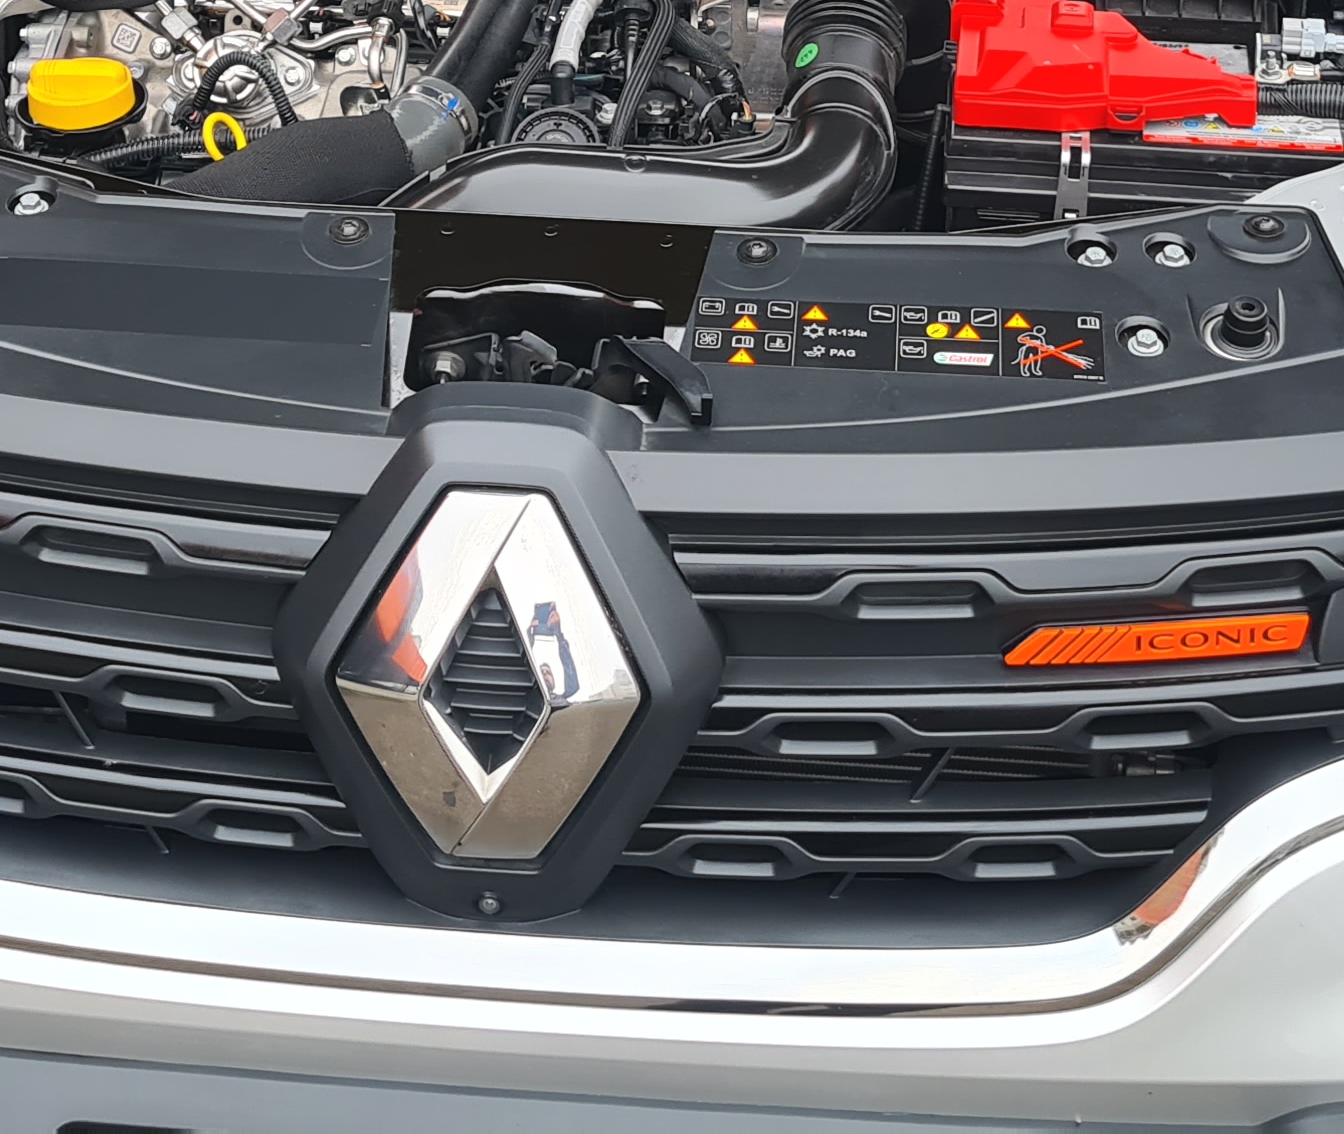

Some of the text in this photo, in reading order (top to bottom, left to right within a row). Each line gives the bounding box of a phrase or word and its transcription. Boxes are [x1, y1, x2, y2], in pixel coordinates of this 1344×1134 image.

[828, 328, 868, 338] R-134a
[829, 348, 856, 357] PAG
[948, 354, 988, 364] Castrol
[1134, 624, 1289, 653] ICONIC
